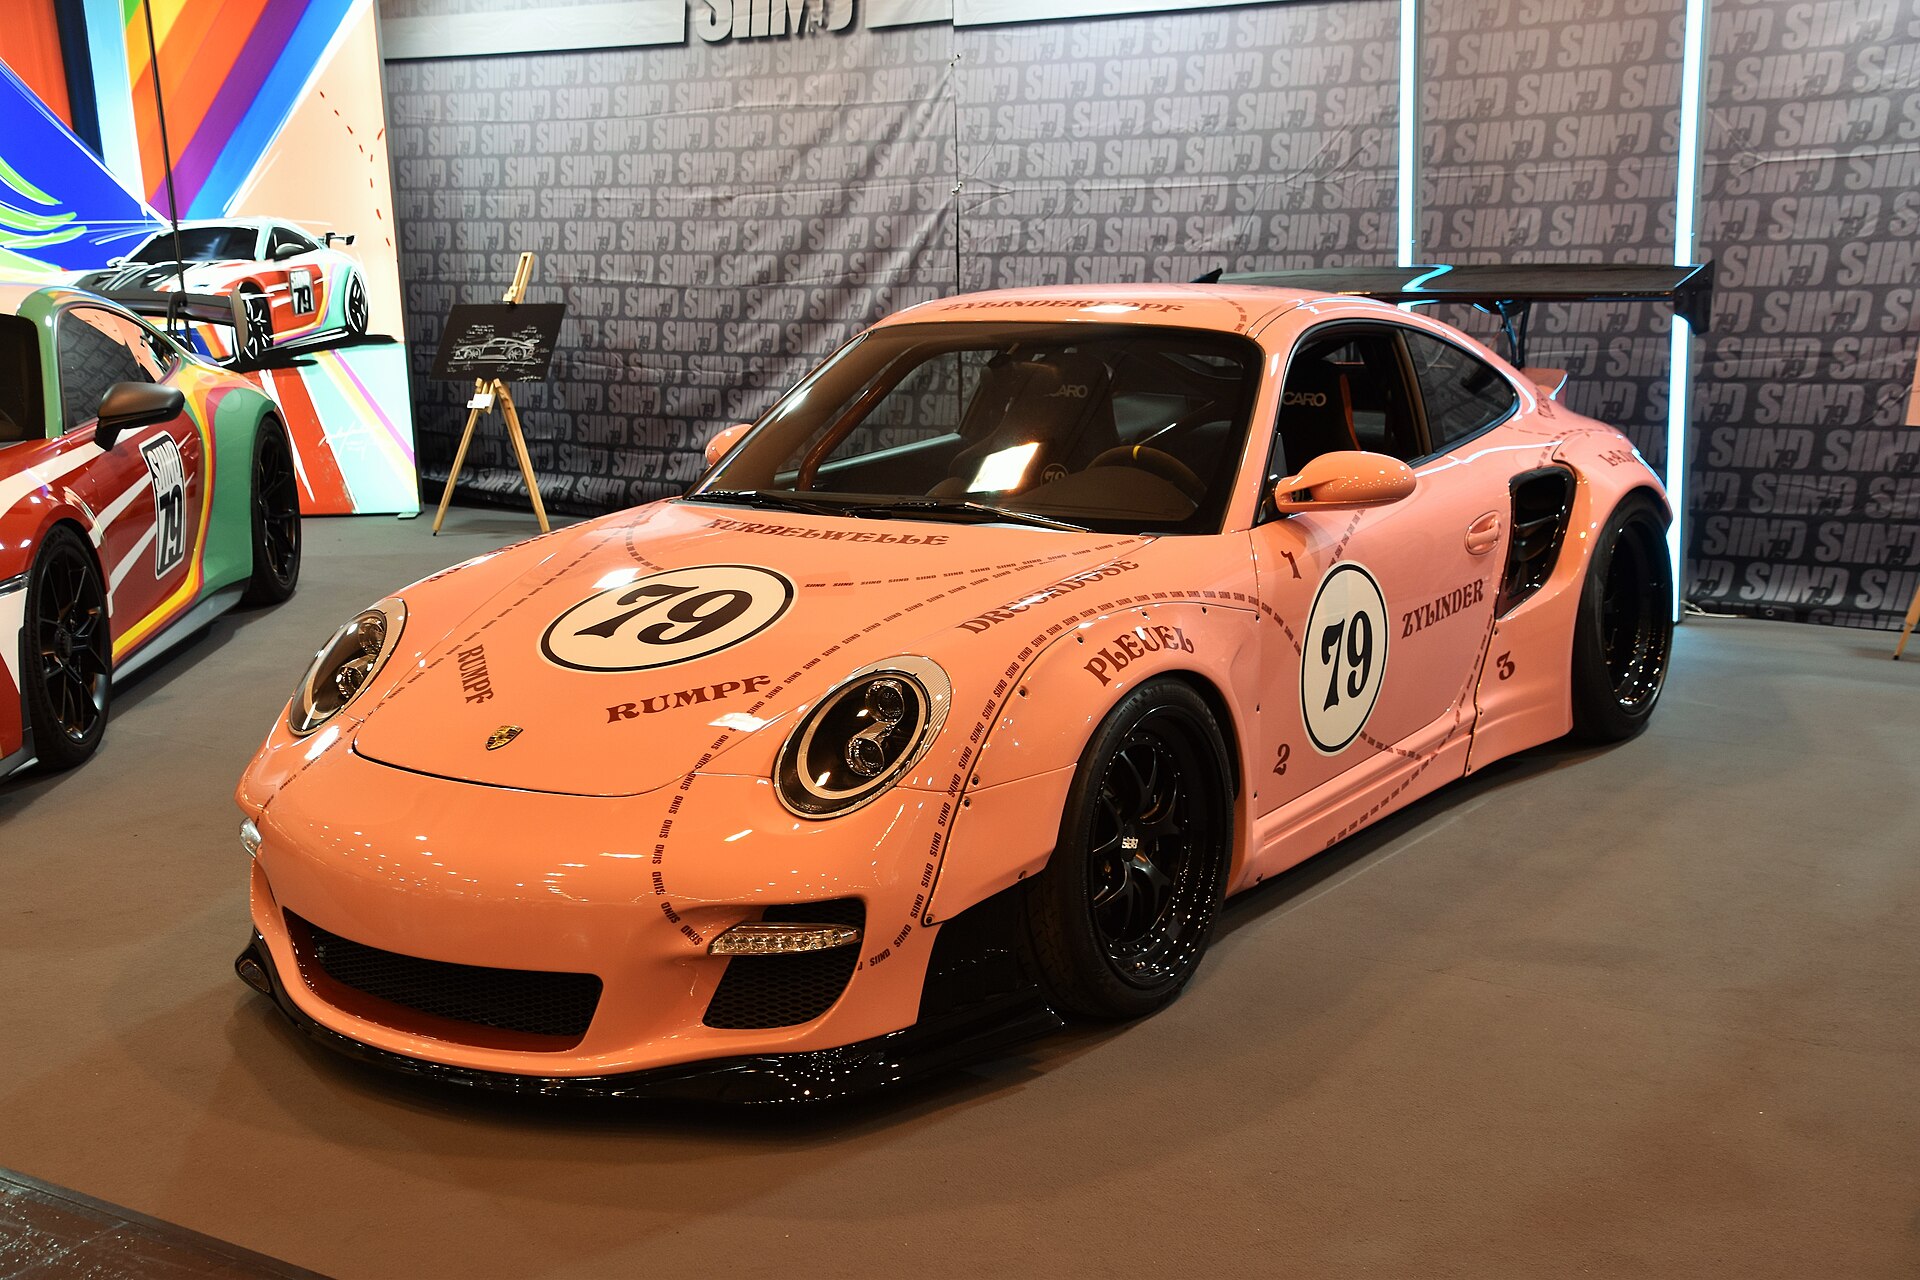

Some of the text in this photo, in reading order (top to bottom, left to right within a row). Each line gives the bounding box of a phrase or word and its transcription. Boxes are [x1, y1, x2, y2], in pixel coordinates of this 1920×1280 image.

[159, 484, 183, 572] 79
[1281, 550, 1302, 579] 1
[573, 583, 754, 645] 79
[1402, 578, 1484, 639] ZYLINDER
[458, 643, 494, 704] RUMPF
[1320, 610, 1373, 713] 79
[1496, 651, 1515, 681] 3
[606, 675, 771, 724] RUMPF
[1273, 743, 1291, 775] 2
